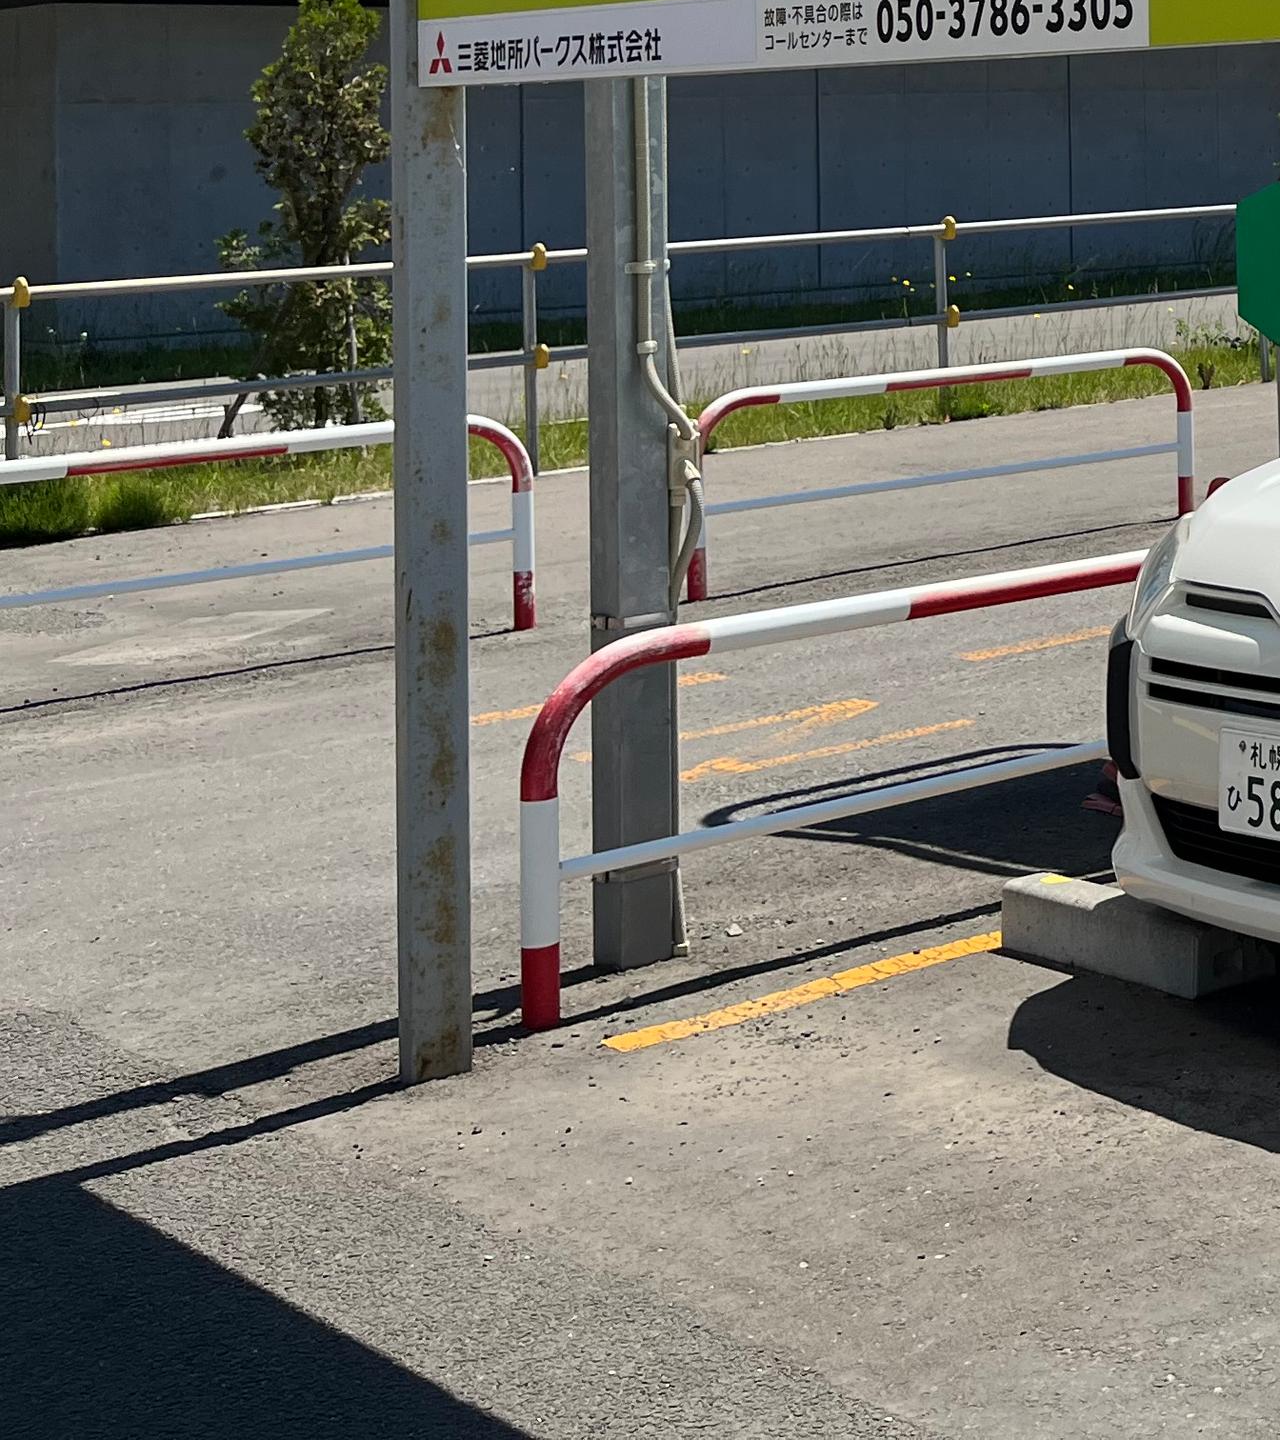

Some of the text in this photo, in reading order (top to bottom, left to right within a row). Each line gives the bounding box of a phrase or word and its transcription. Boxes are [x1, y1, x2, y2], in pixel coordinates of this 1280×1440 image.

[764, 2, 863, 30] 故障・不具合の際は
[457, 28, 662, 72] 三菱地所パークス株式会社
[764, 26, 868, 51] コールセンターまで
